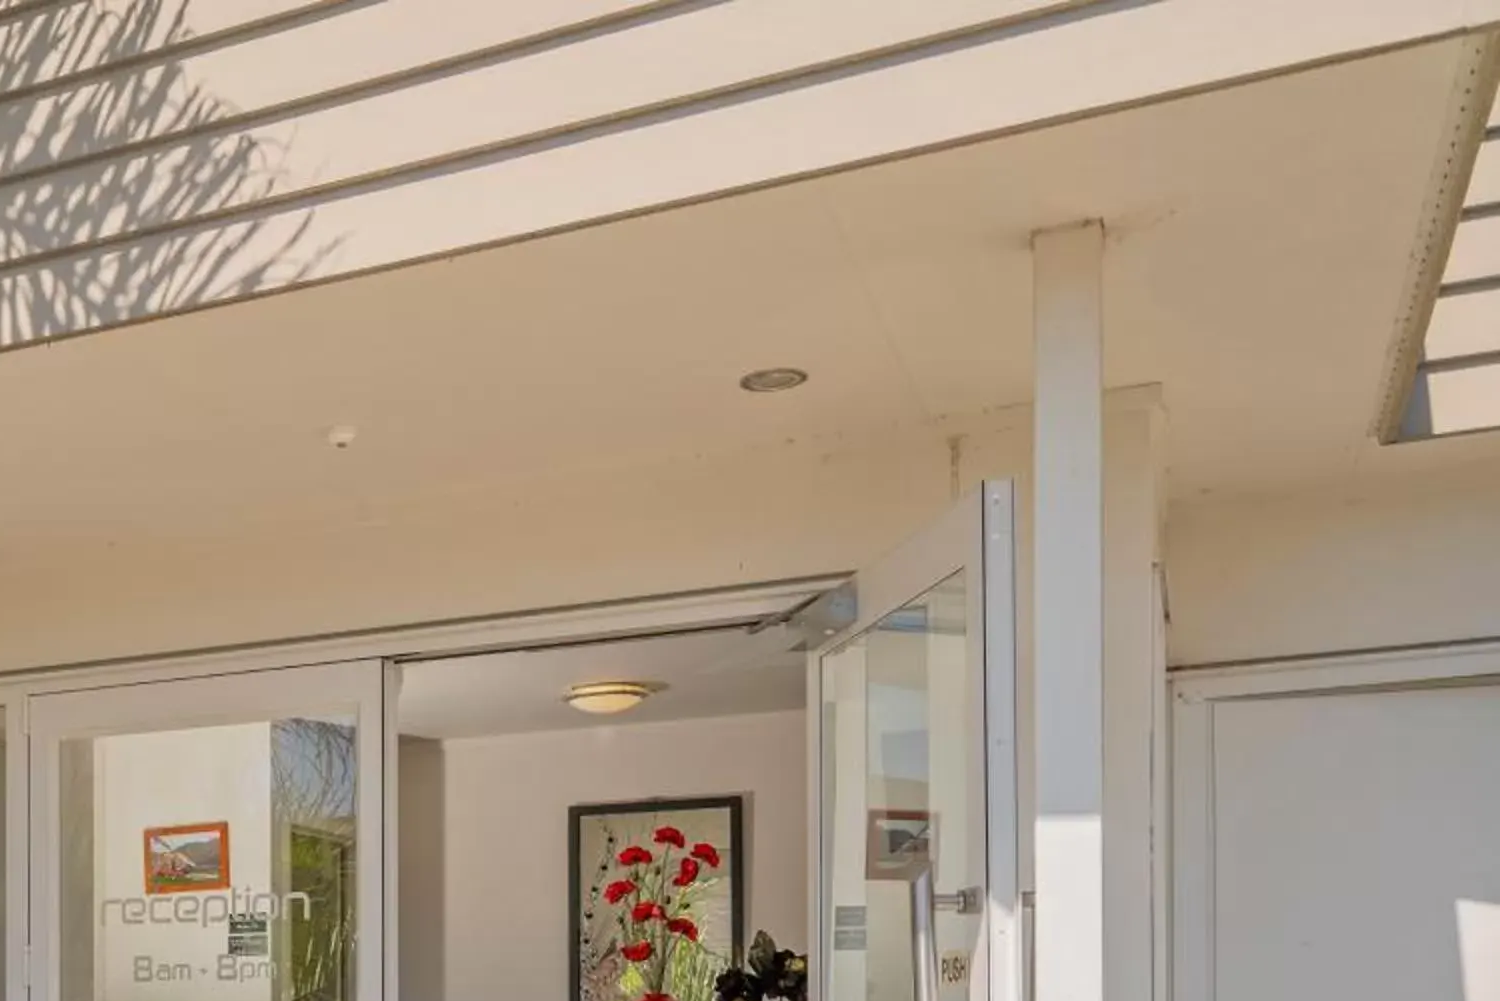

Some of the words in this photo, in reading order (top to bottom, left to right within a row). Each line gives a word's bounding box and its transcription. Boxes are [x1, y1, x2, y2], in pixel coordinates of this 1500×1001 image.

[101, 887, 310, 927] reception
[133, 955, 192, 982] 8am
[217, 954, 277, 982] 8pm
[941, 956, 967, 984] PUSH
